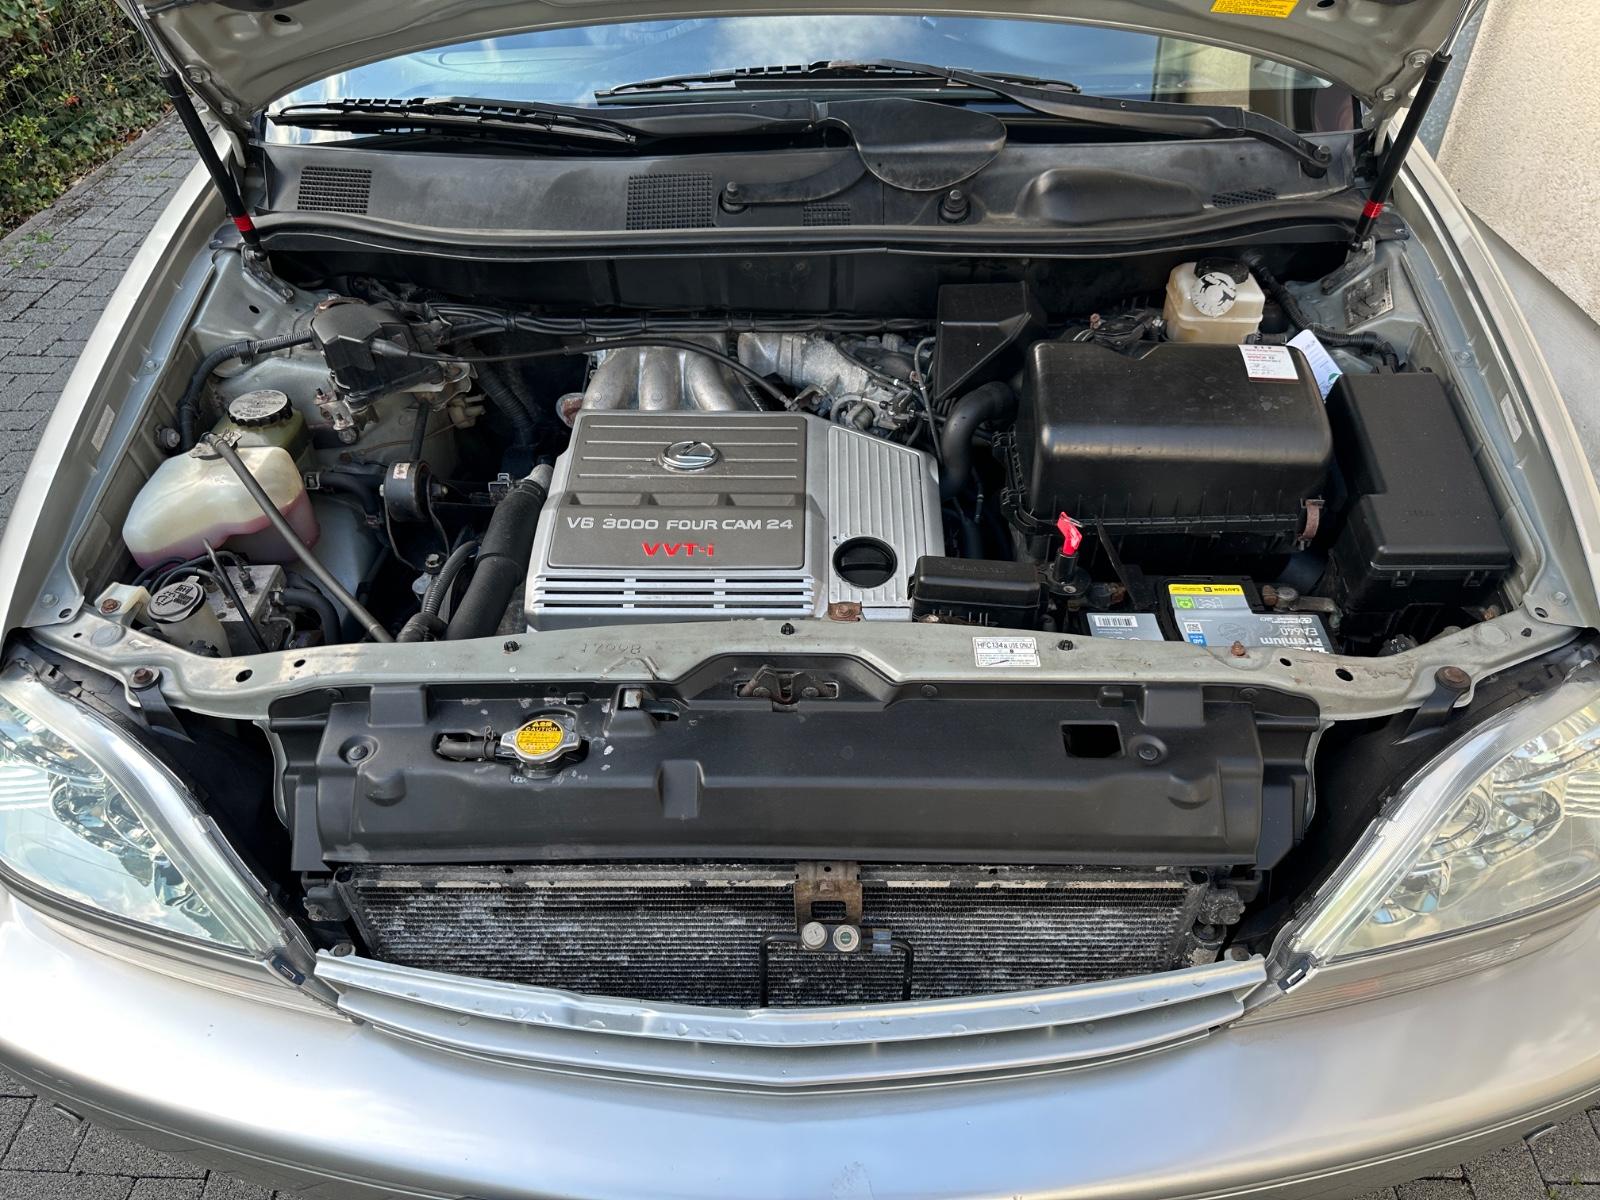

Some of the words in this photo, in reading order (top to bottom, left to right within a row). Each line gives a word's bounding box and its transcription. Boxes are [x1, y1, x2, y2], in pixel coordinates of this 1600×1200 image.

[566, 516, 595, 529] V6
[602, 518, 659, 530] 3000
[666, 519, 718, 530] FOUR
[721, 519, 762, 530] CAM
[766, 519, 794, 530] 24
[641, 543, 715, 558] VVT-i
[1260, 637, 1324, 646] Premium
